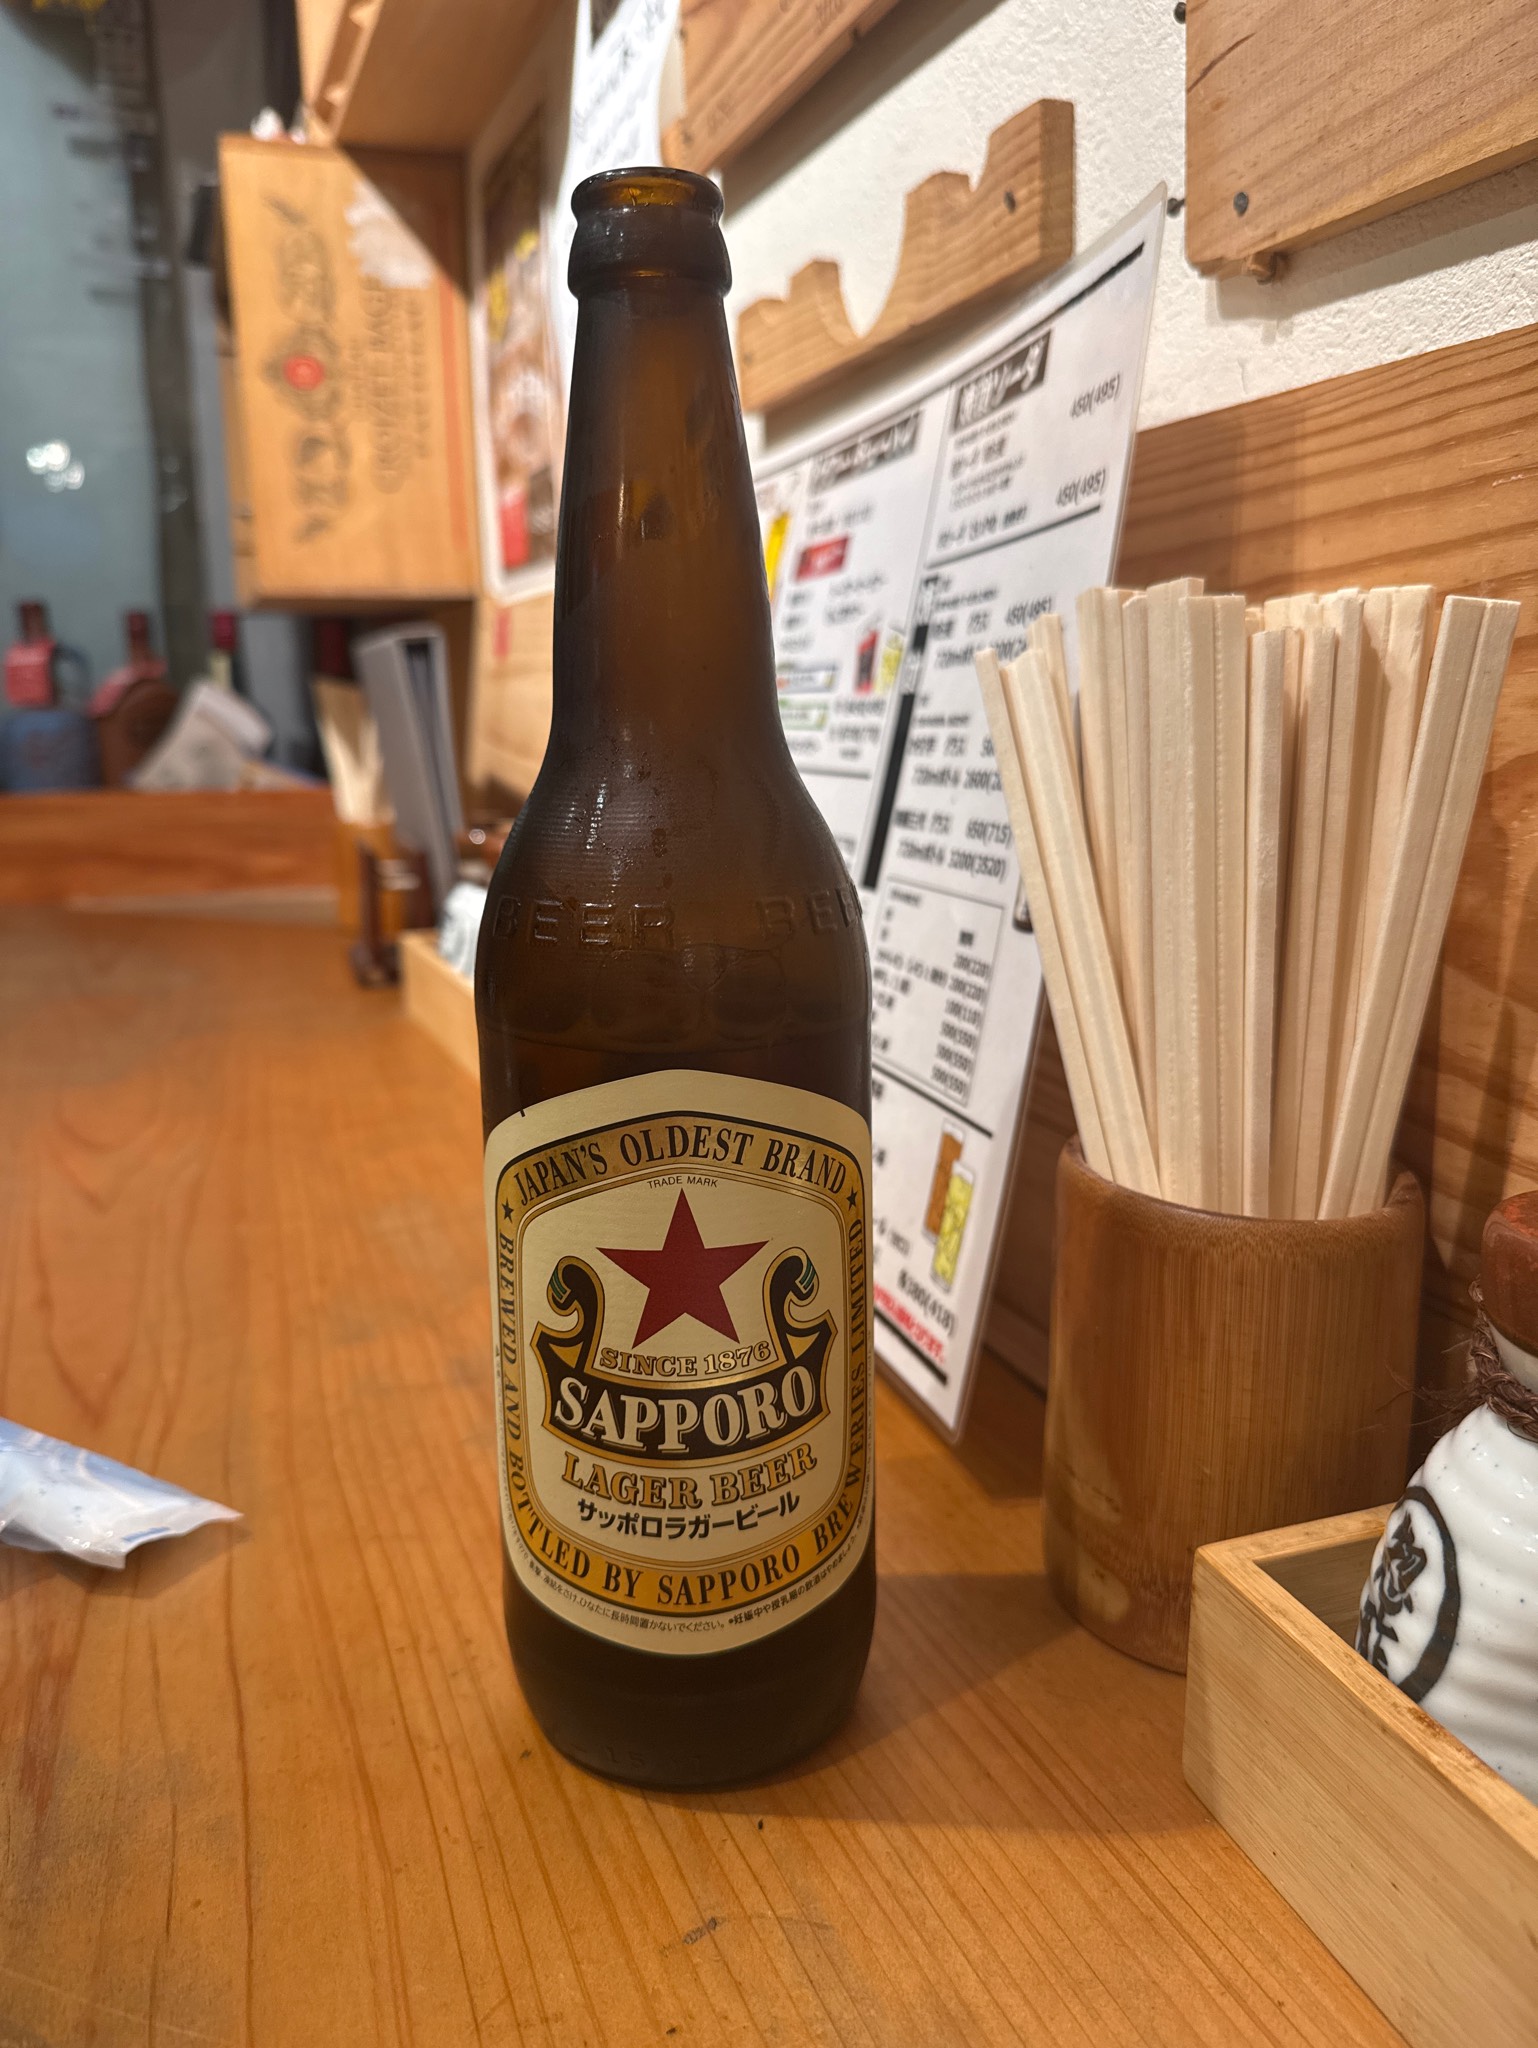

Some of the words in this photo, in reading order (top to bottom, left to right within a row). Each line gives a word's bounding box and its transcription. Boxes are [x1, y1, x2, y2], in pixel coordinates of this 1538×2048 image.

[492, 896, 675, 950] BEER
[514, 1141, 608, 1207] JAPAN'S
[619, 1124, 754, 1167] OLDEST
[760, 1138, 848, 1197] BRAND
[647, 1176, 683, 1190] TRADE
[686, 1175, 719, 1188] MARK
[499, 1229, 516, 1365] BREWED
[849, 1218, 865, 1353] LIMITED
[600, 1347, 698, 1378] SINCE
[704, 1340, 772, 1376] 1876
[504, 1374, 521, 1441] AND
[555, 1365, 817, 1453] SAPPORO
[562, 1451, 704, 1511] LAGER
[711, 1442, 818, 1507] BEER
[812, 1361, 865, 1557] BREWERIES
[508, 1450, 591, 1580] BOTTLED
[576, 1490, 801, 1541] サッポロラガービール
[604, 1561, 645, 1600] BY
[656, 1544, 802, 1607] SAPPORO
